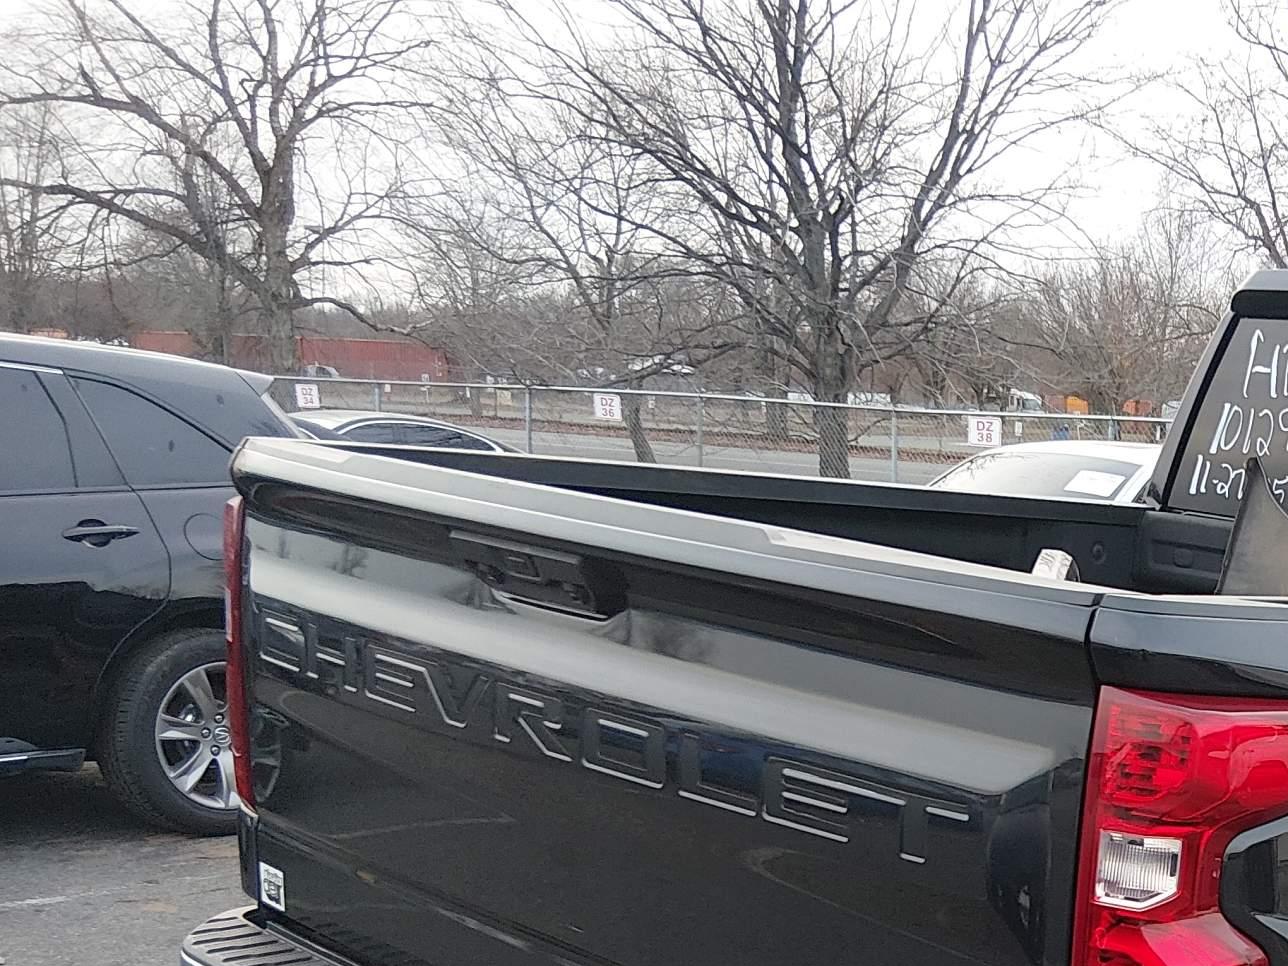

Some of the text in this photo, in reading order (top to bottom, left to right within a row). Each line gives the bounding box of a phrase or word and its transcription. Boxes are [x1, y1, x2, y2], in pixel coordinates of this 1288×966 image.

[600, 397, 615, 408] DZ
[601, 407, 615, 418] 36
[976, 420, 993, 432] DZ
[976, 432, 993, 443] 38
[257, 609, 972, 864] CHEVROLET
